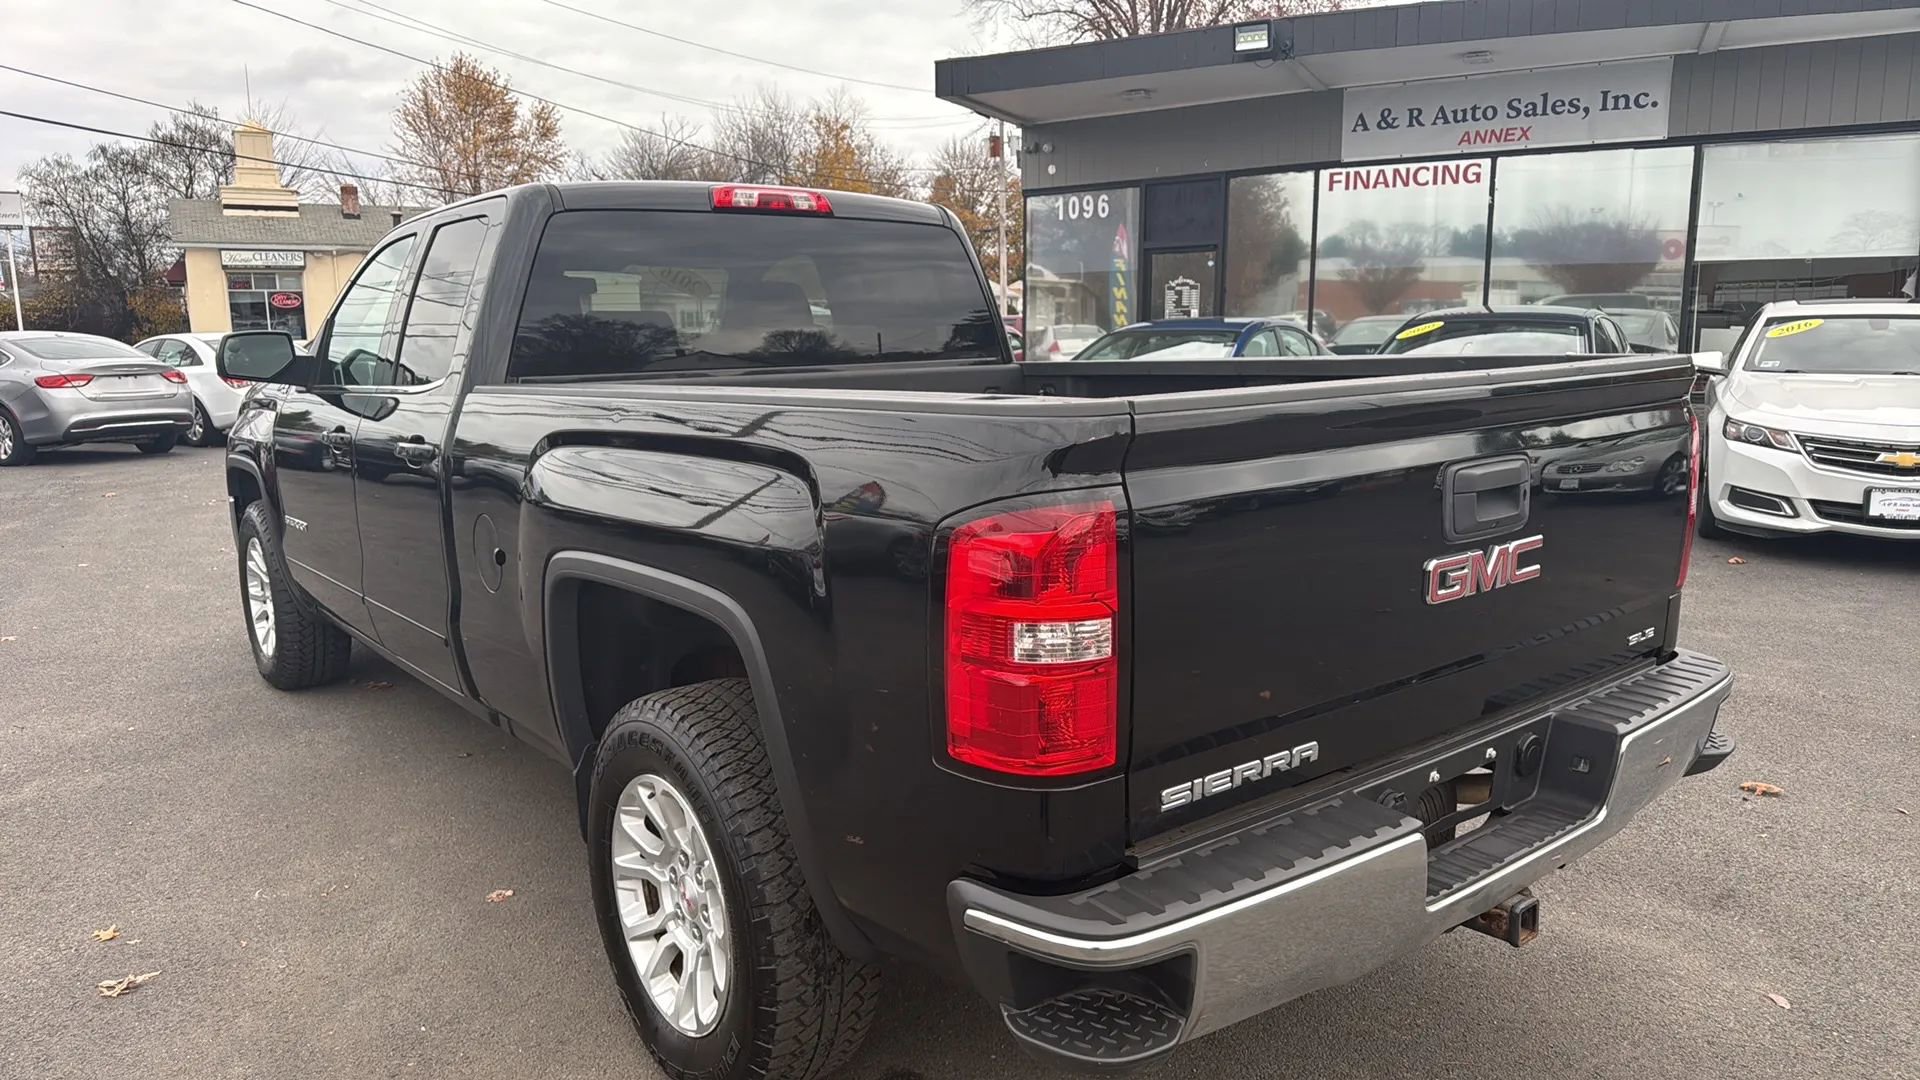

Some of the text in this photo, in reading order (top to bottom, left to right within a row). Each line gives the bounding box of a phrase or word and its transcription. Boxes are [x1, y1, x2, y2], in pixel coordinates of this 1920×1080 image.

[1351, 89, 1659, 133] A & R Auto Sales, Inc.
[1457, 126, 1533, 146] ANNEX
[1327, 162, 1483, 192] FINANCING
[1055, 194, 1110, 221] 1096
[252, 252, 303, 262] CLEANERS
[1778, 322, 1813, 335] 2016
[1423, 534, 1543, 605] GMC
[1160, 740, 1319, 813] SIERRA
